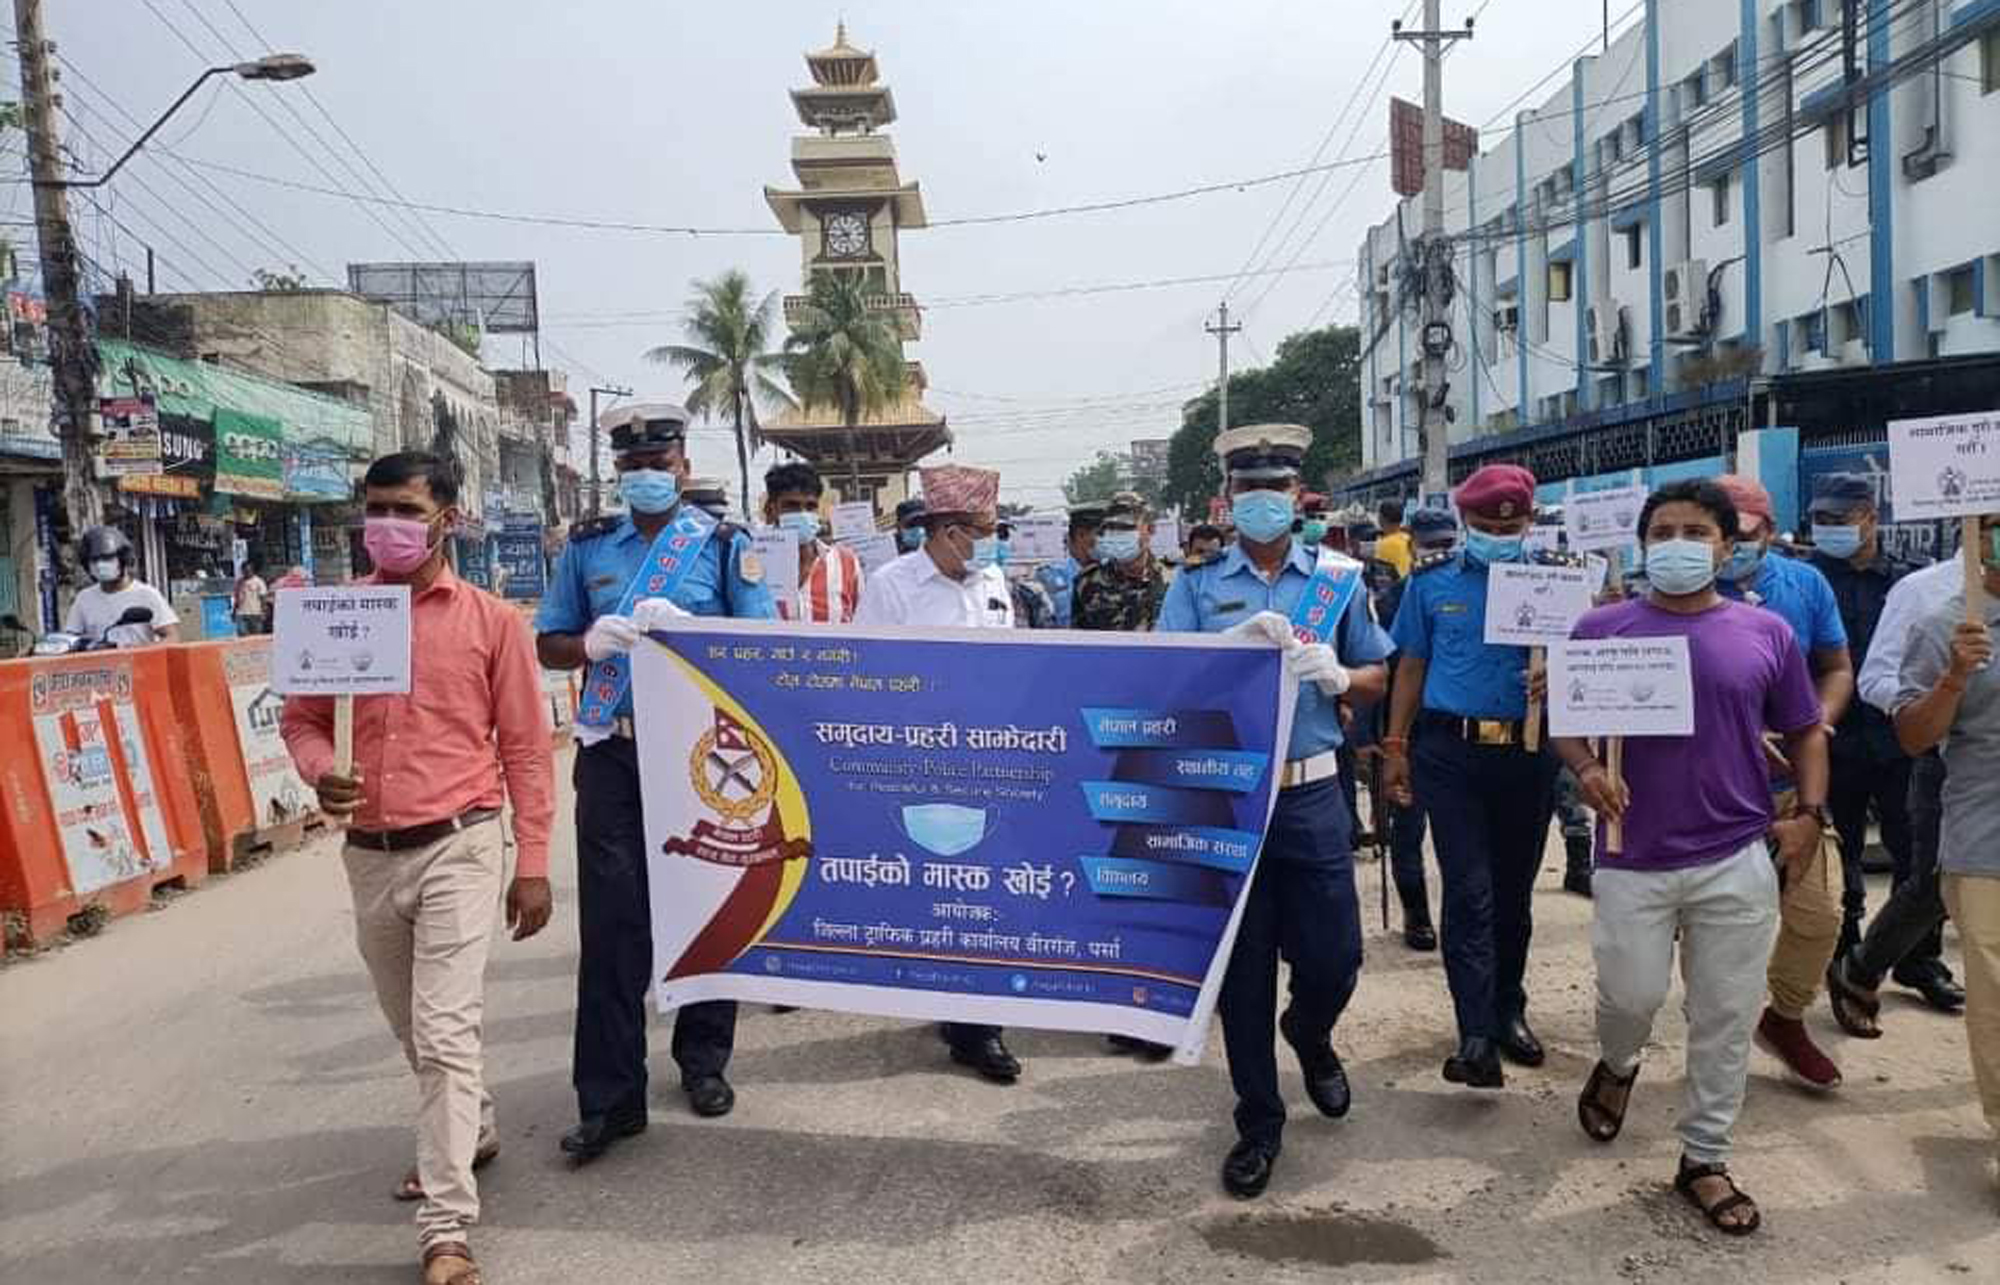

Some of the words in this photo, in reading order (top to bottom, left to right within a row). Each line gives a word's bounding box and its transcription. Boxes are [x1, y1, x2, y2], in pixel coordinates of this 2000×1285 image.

[163, 431, 203, 460] SUNG
[363, 626, 371, 639] ?
[815, 720, 958, 749] समुदाय-प्रहरी
[966, 724, 1068, 754] साझेदारी
[1100, 717, 1137, 733] नेपाल
[1142, 717, 1177, 735] प्रहरी
[973, 759, 1053, 784] Partnership
[1233, 762, 1255, 778] तह
[1147, 834, 1208, 852] सामाजिक
[923, 861, 992, 891] मास्क
[1003, 861, 1055, 899] खोई
[1060, 870, 1075, 897] ?
[813, 917, 857, 942] जिल्ला
[864, 923, 913, 947] ट्राफिक
[919, 925, 954, 949] प्रहरी
[960, 928, 1020, 953] कार्यालय
[1087, 937, 1121, 960] पर्सा
